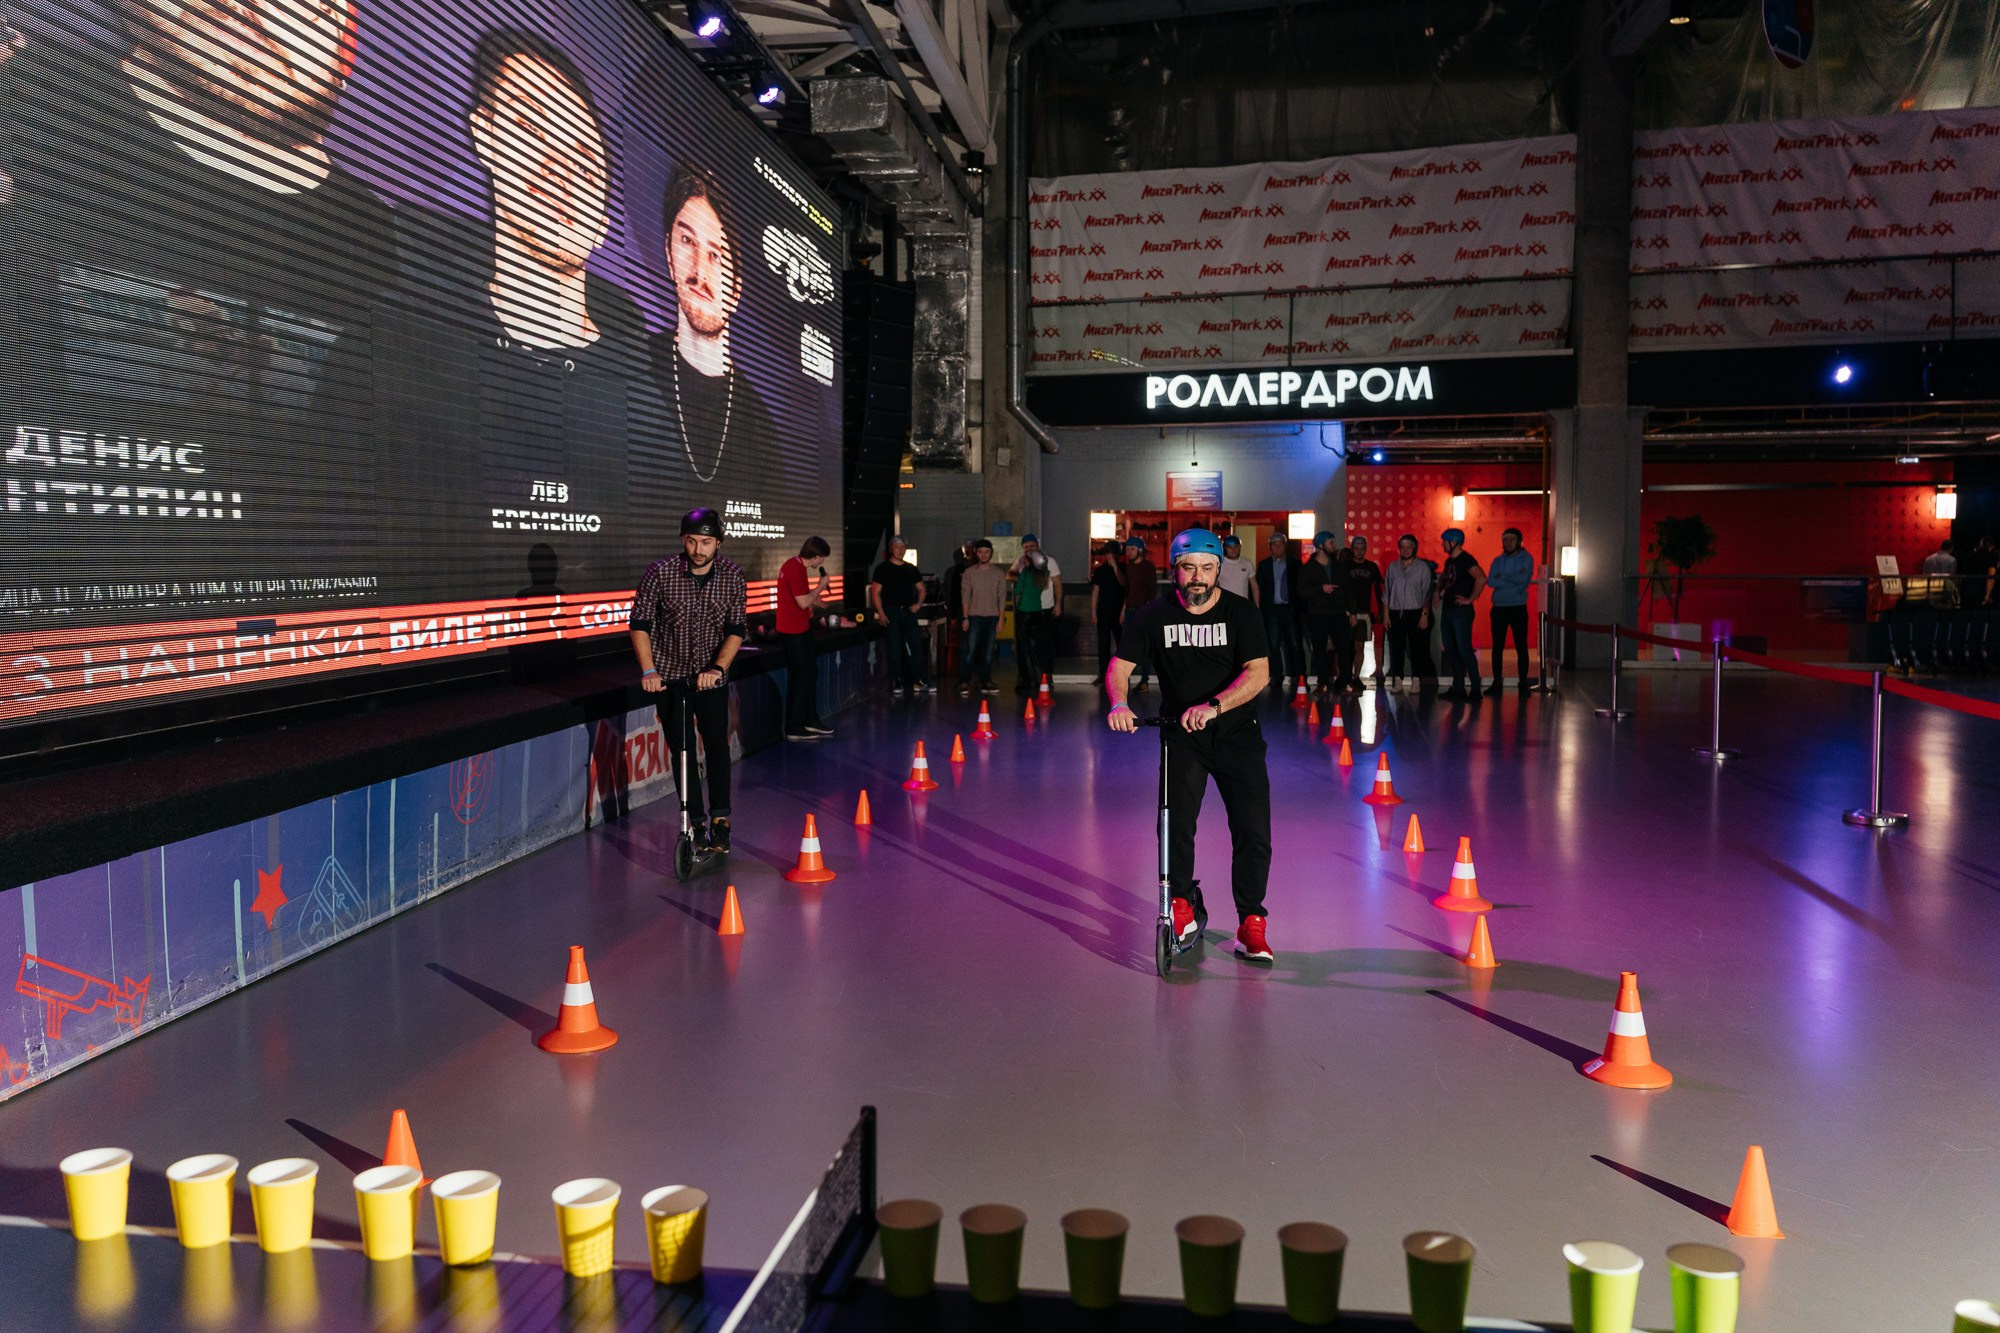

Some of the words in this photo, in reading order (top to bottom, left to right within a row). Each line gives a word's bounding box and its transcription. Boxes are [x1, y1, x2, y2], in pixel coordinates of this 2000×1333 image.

[1146, 366, 1434, 409] РОЛЛЕРДРОМ
[6, 425, 205, 474] ДЕНИС
[530, 480, 568, 504] ЛЕВ
[492, 508, 601, 533] ЕРЕМЕНКО
[389, 611, 527, 654] БИЛЕТЫ
[1163, 622, 1228, 648] PUMA
